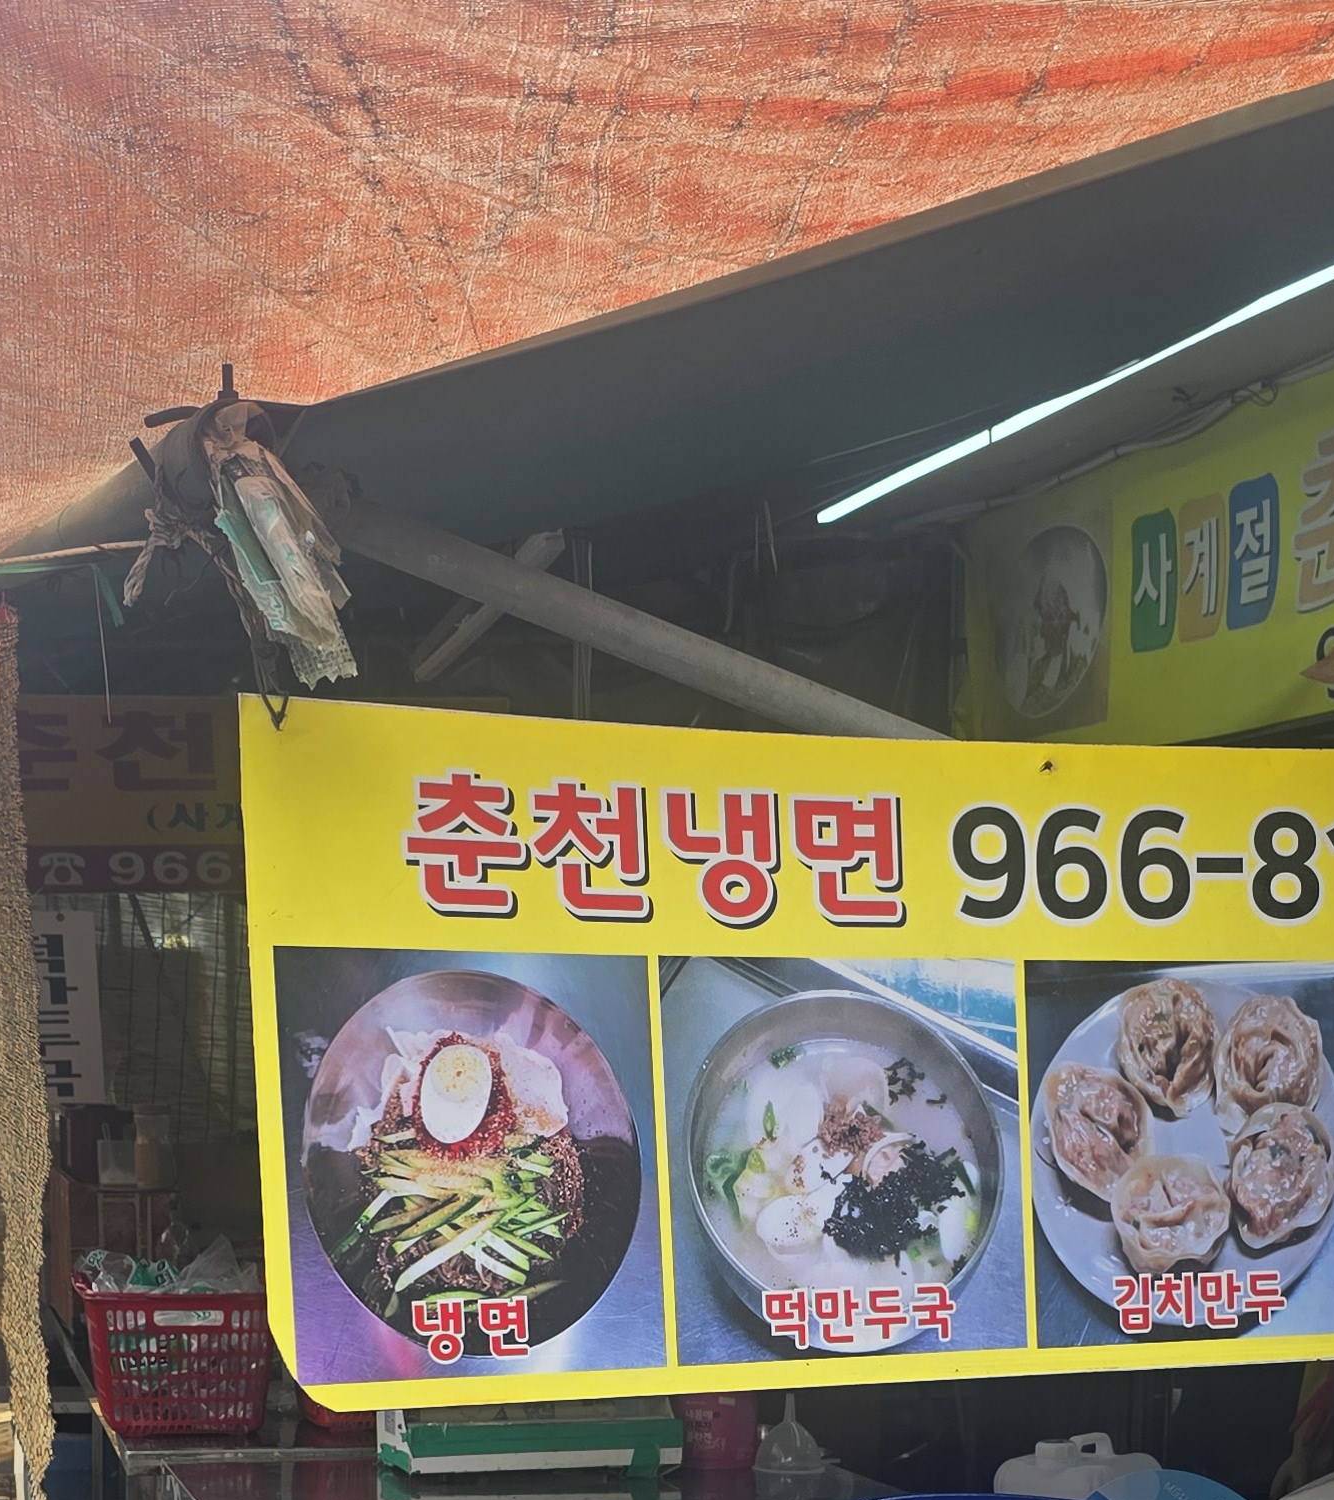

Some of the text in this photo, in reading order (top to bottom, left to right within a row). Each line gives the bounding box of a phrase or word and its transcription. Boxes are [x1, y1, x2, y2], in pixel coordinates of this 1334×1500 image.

[1132, 485, 1272, 627] 사계절
[405, 765, 909, 928] 춘천냉면
[411, 1296, 530, 1364] 냉면
[762, 1283, 957, 1349] 떡만두국
[1112, 1270, 1288, 1331] 김치만두
